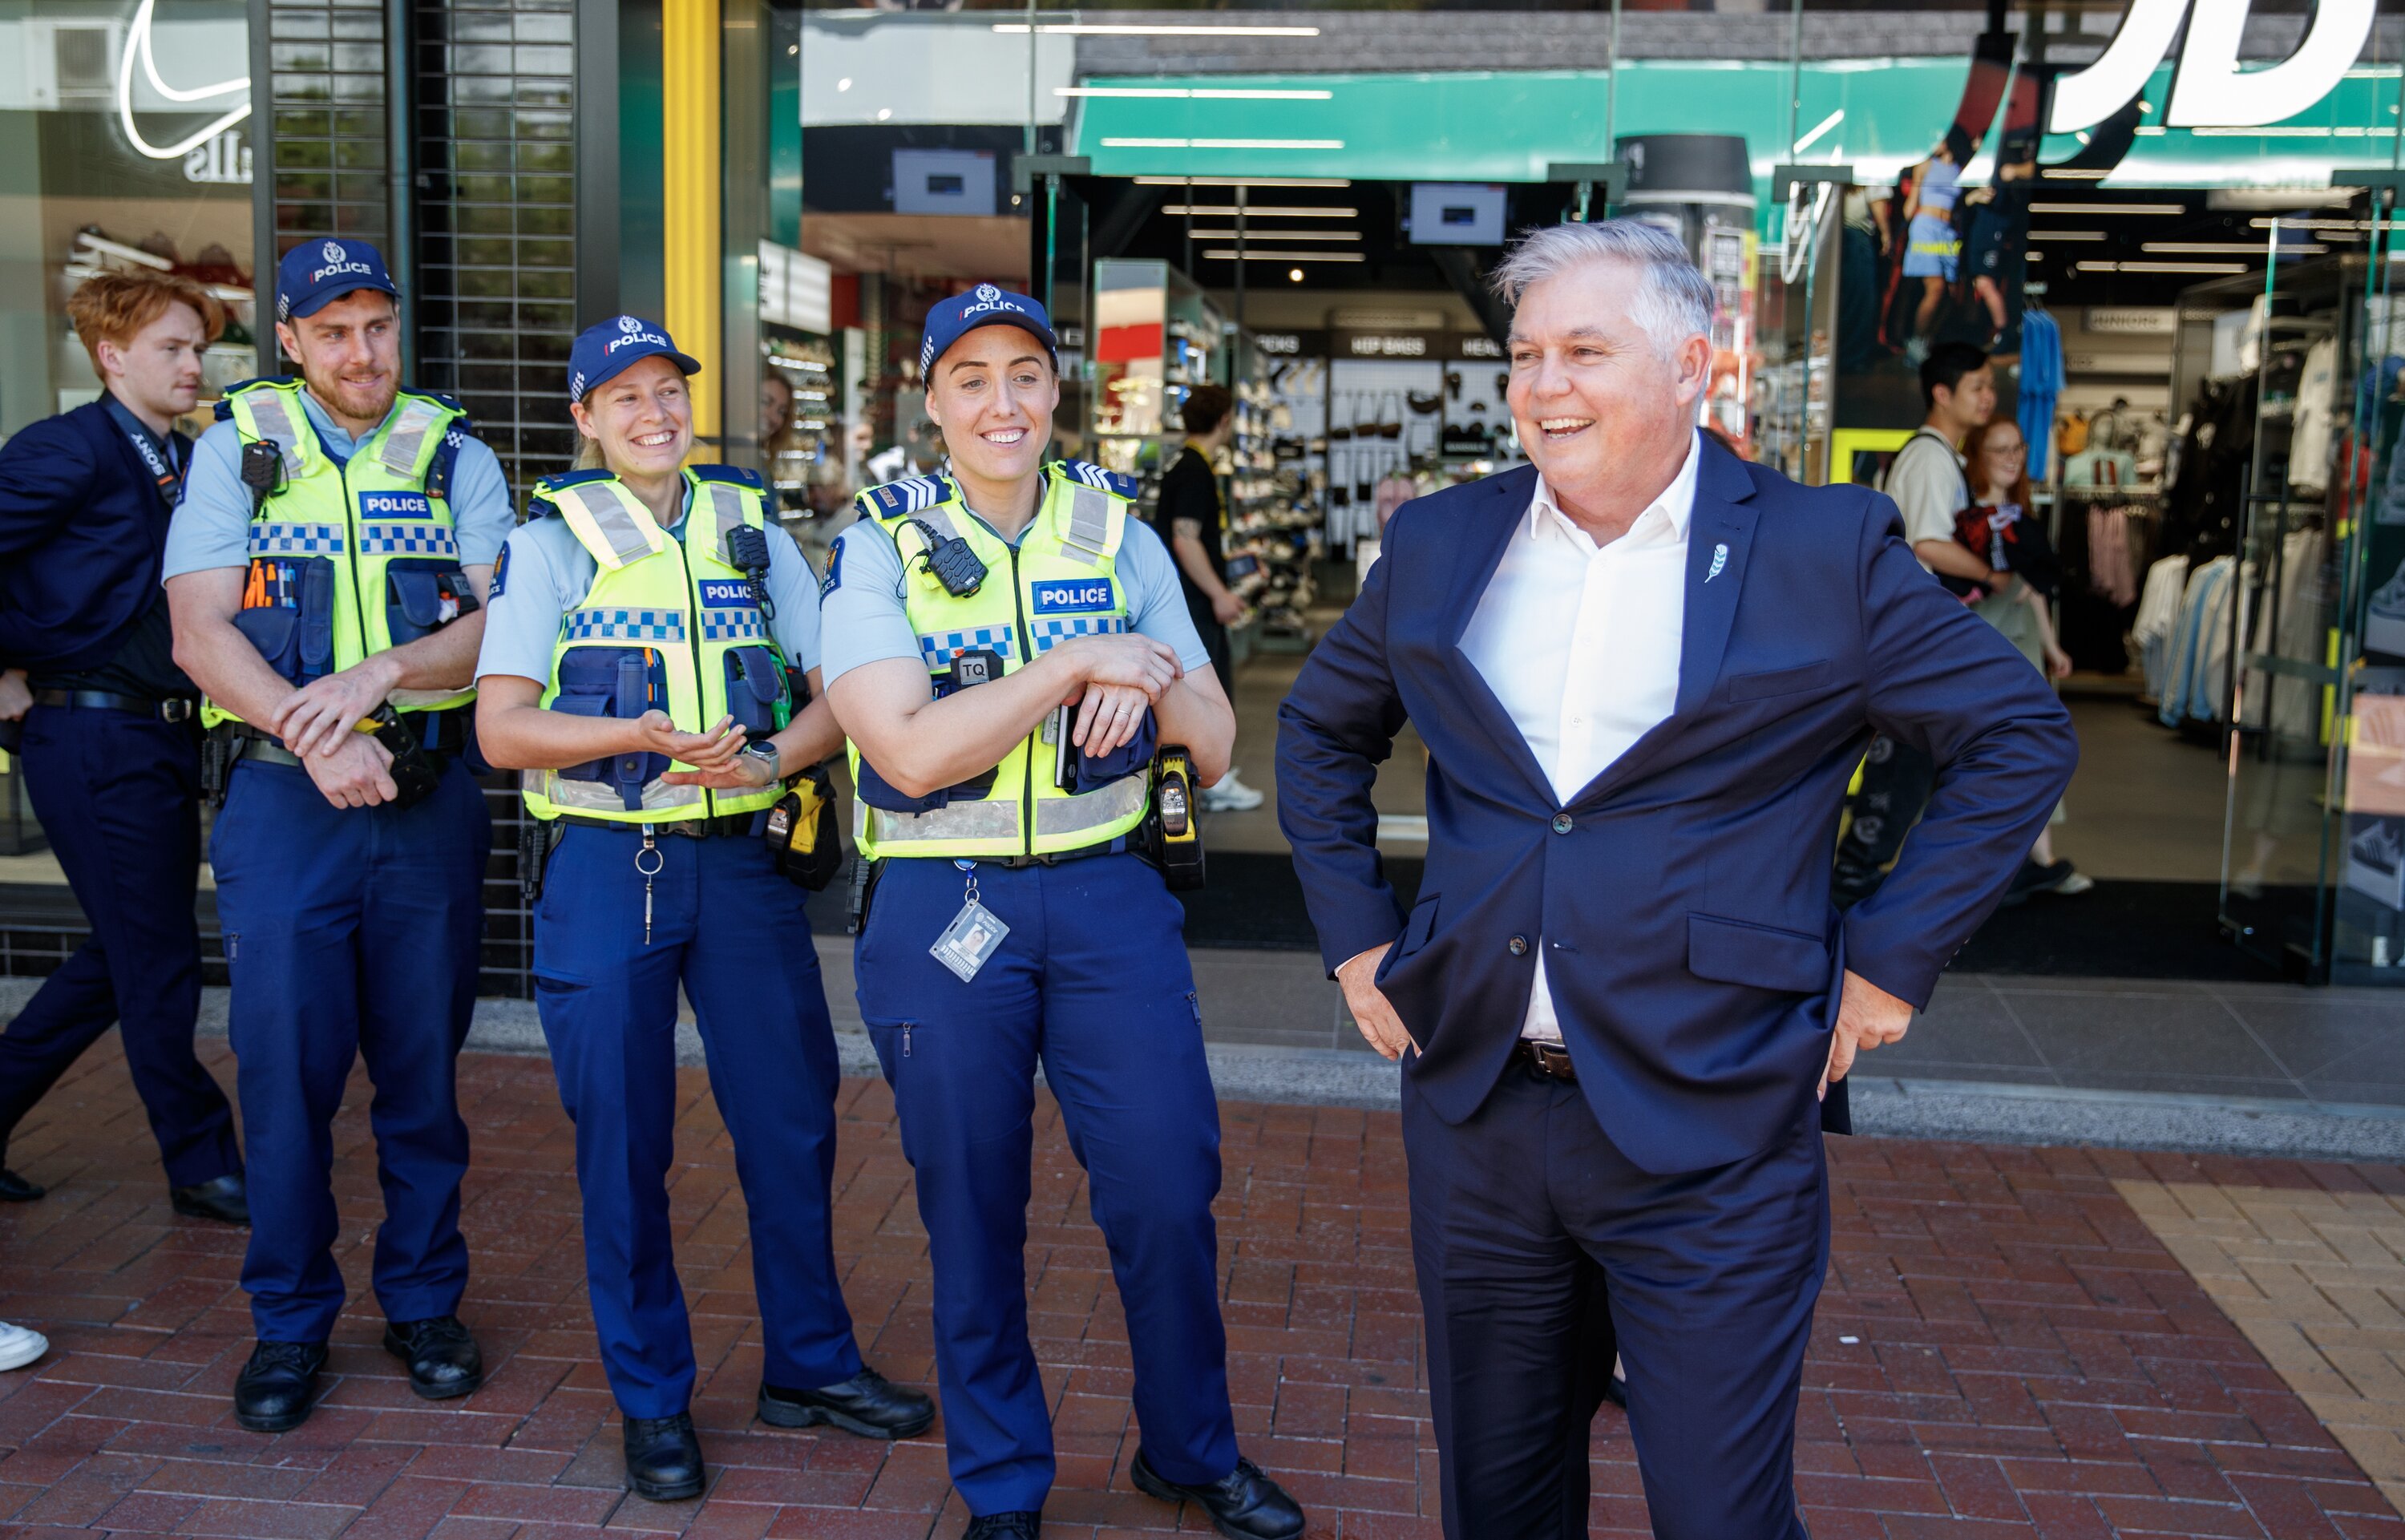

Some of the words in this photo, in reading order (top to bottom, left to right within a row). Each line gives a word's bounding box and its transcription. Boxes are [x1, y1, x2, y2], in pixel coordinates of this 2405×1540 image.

[314, 262, 372, 282] POLICE
[610, 332, 667, 354] POLICE
[131, 433, 166, 476] SONY
[366, 497, 427, 512] POLICE
[705, 585, 752, 599] POLIC
[1041, 588, 1107, 605] POLICE
[962, 663, 985, 677] TQ
